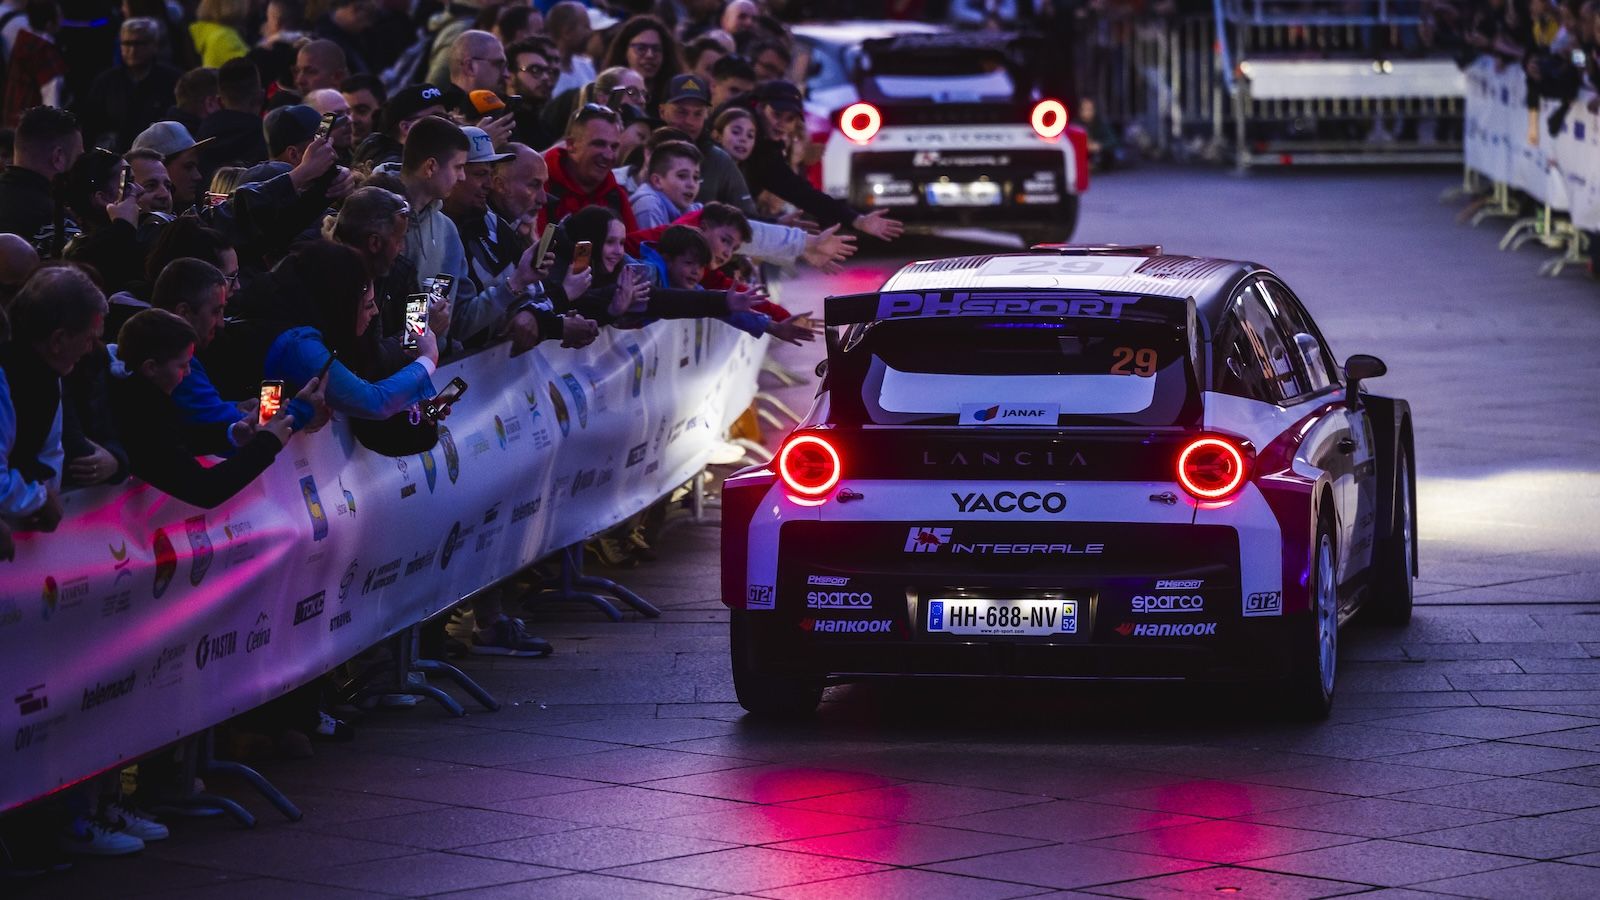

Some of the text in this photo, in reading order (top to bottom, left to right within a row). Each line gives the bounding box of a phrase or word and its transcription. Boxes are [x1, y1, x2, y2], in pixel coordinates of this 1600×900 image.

[1010, 260, 1104, 274] 29
[876, 292, 1142, 320] PHSPORT
[1110, 346, 1158, 378] 29
[1002, 409, 1046, 418] JANAF
[923, 451, 1088, 466] LANCIA
[951, 490, 1067, 514] YACCO
[951, 543, 1105, 554] INTEGRALE
[807, 591, 873, 609] sparco
[1131, 595, 1204, 613] sparco
[933, 618, 939, 626] F
[950, 606, 1058, 628] HH-688-NV
[1062, 618, 1076, 630] 52
